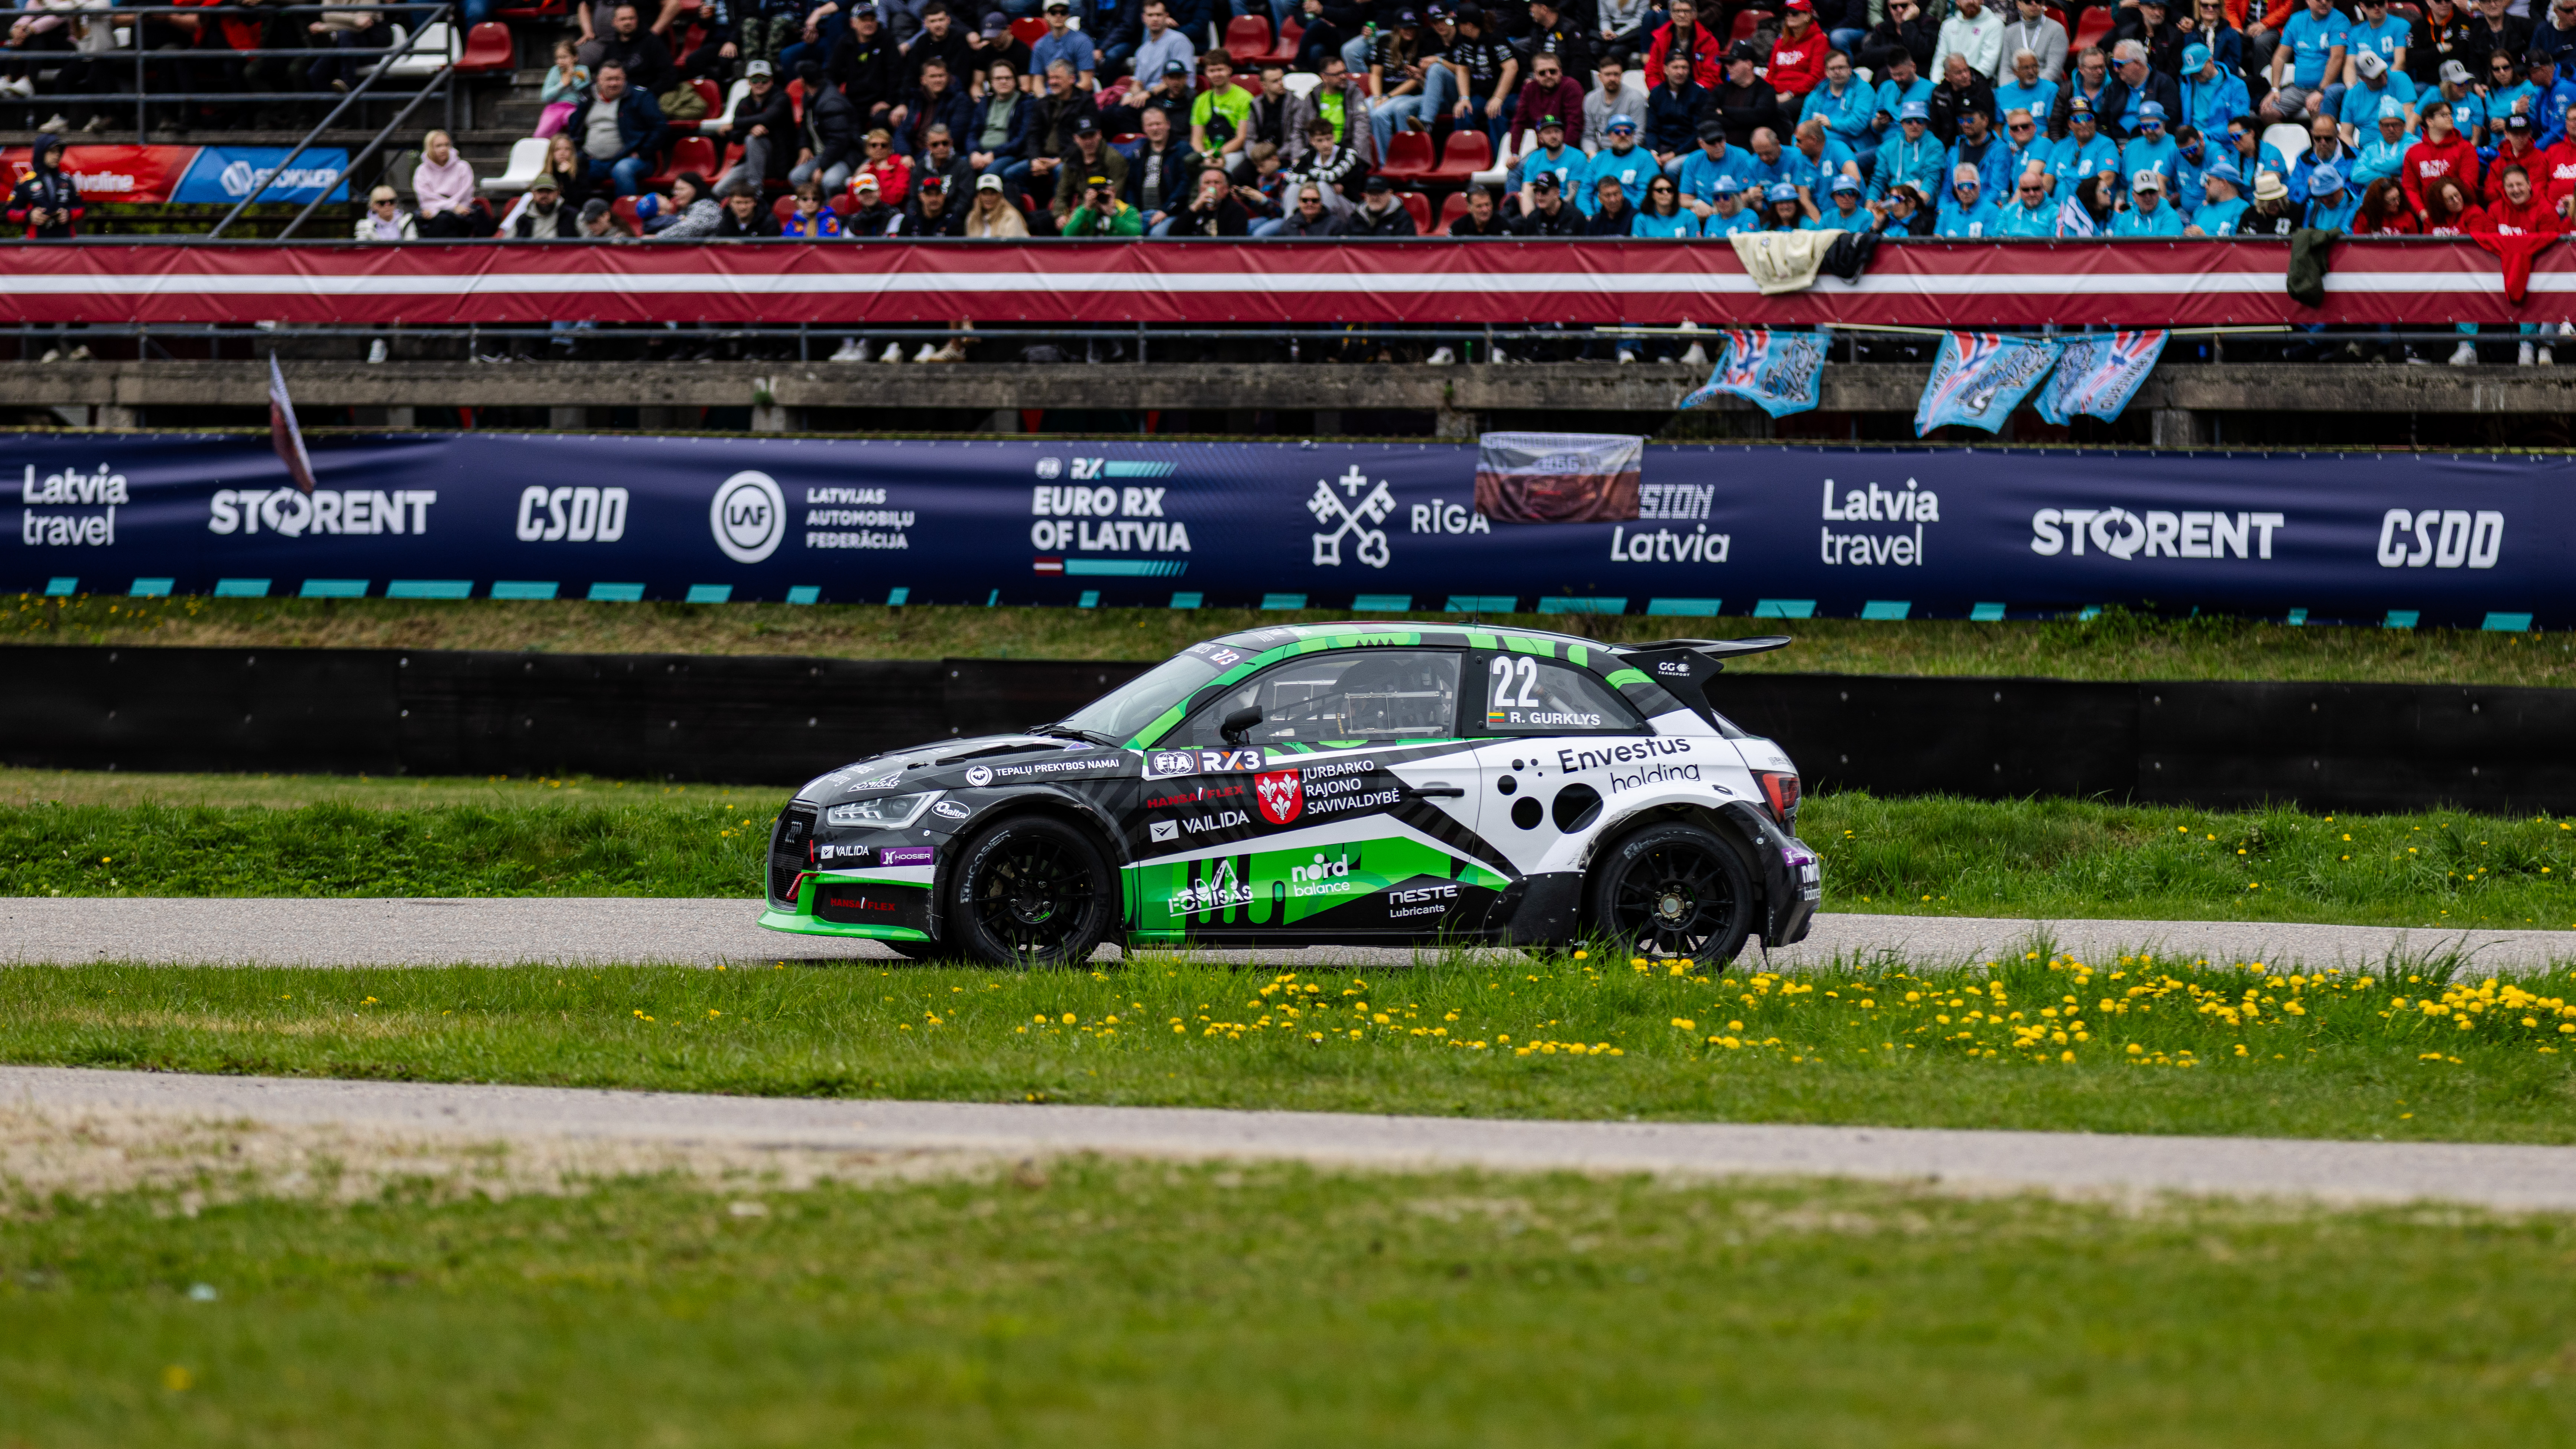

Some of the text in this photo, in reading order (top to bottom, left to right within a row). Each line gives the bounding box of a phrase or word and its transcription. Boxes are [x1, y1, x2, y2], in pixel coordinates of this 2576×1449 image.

[22, 462, 129, 504] Latvia
[806, 488, 887, 505] LATVIJAS
[208, 487, 437, 537] STORENT
[516, 485, 629, 542] CSDD
[1032, 485, 1166, 517] EURO RX
[1637, 484, 1715, 519] SION
[1822, 477, 1939, 522] Latvia
[22, 506, 116, 546] travel
[730, 505, 768, 526] LAF
[1411, 500, 1491, 535] RĪGA
[806, 530, 909, 550] FEDERĀCIJA
[1030, 520, 1192, 552] OF LATVIA
[1611, 524, 1730, 563] Latvia
[1821, 523, 1923, 566] travel
[2030, 506, 2284, 560] STORENT
[2377, 508, 2505, 569] CSDD
[1659, 662, 1675, 671] GG
[1493, 656, 1539, 707] 22
[1510, 712, 1601, 725] R. GURKLYS
[995, 759, 1119, 776] TEPALŲ PREKYBOS NAMAI
[1202, 751, 1261, 772] RX3
[1557, 737, 1691, 774] Envestus
[1302, 760, 1375, 783] JURBARKO
[1610, 763, 1701, 794] holding
[1305, 777, 1362, 798] RAJONO
[1308, 788, 1400, 815] SAVIVALDYBĖ
[1182, 809, 1250, 834] VAILIDA
[836, 845, 870, 857] VAILIDA
[1168, 884, 1253, 913] FOMISAS
[1294, 880, 1351, 898] balance
[1389, 884, 1457, 905] NESTE
[831, 897, 896, 911] HANSA FLEX
[1390, 904, 1445, 918] Lubricants
